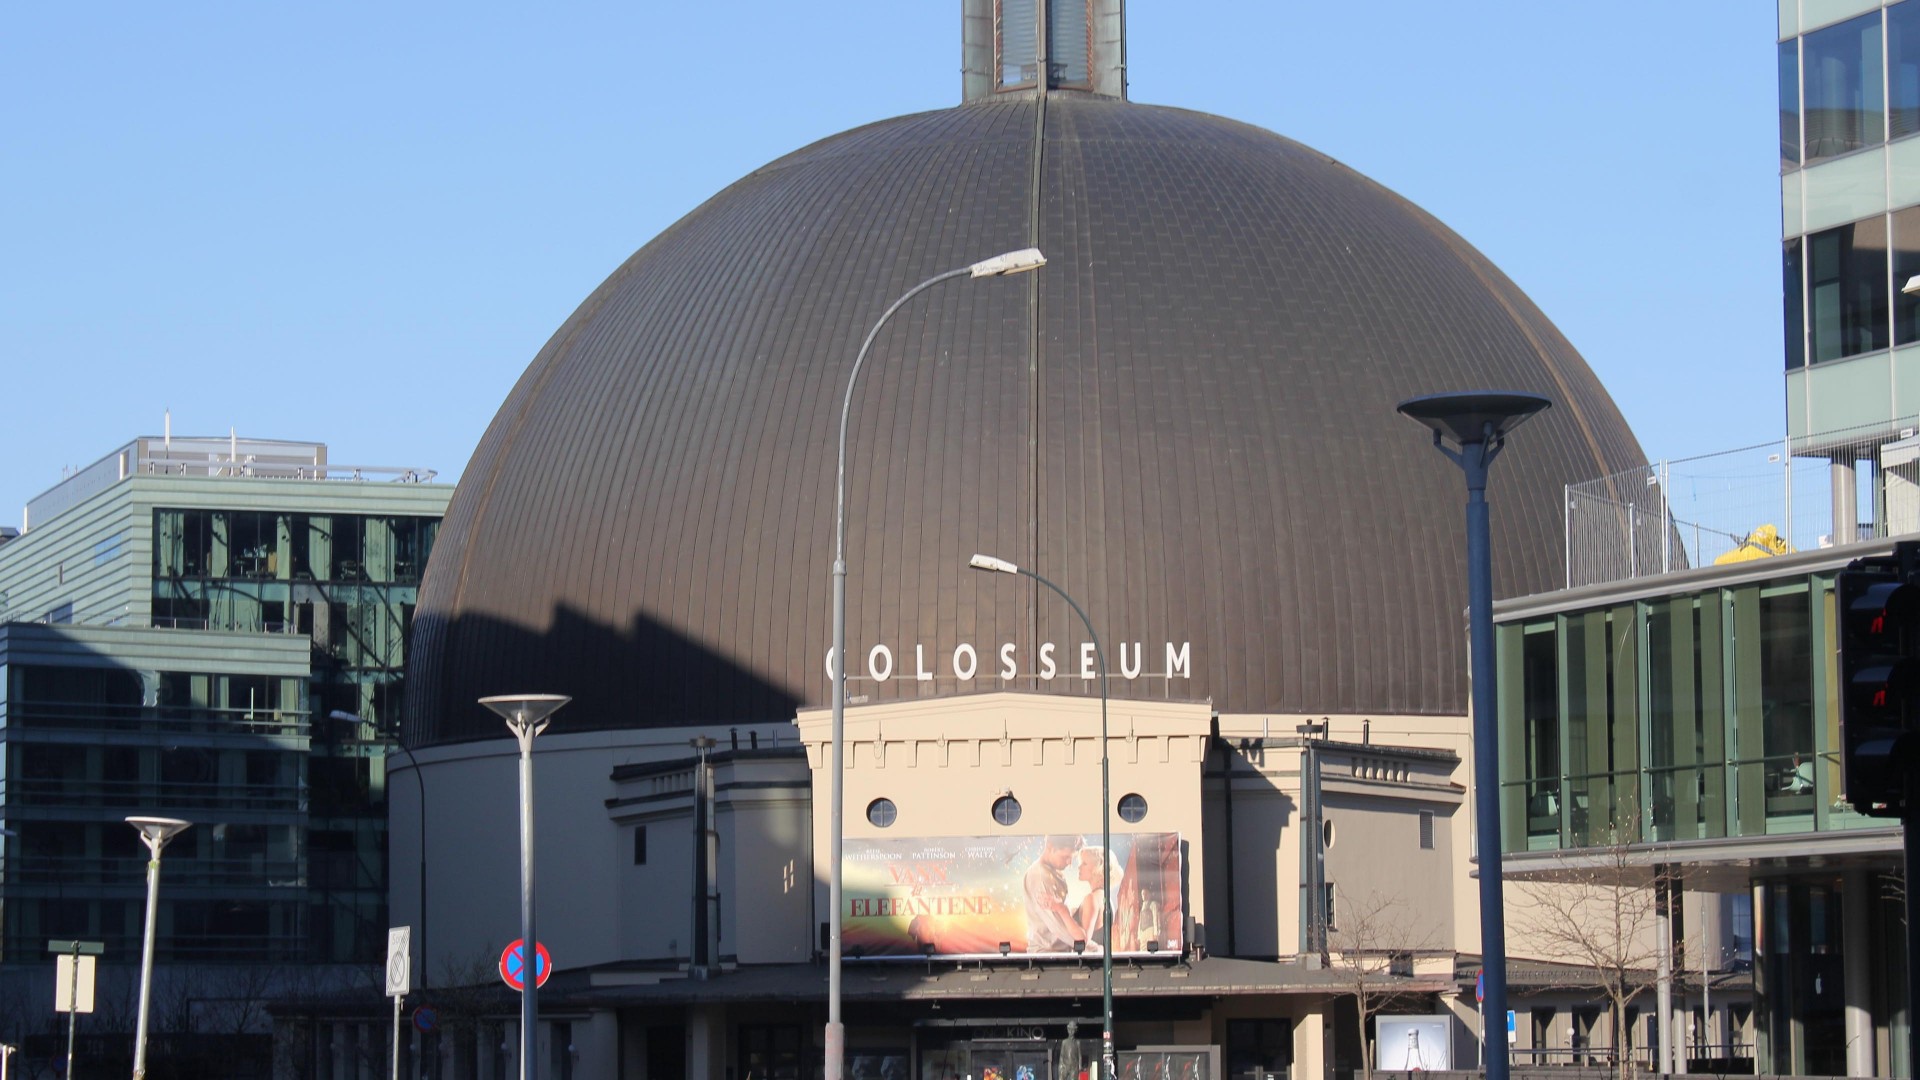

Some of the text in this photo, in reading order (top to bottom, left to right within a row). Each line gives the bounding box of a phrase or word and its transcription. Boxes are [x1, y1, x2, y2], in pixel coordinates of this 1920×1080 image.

[826, 642, 1190, 682] COLOSSEUM
[912, 852, 956, 860] PATTINSON
[850, 895, 991, 917] ELEFANTENE
[1006, 1026, 1044, 1039] KINO
